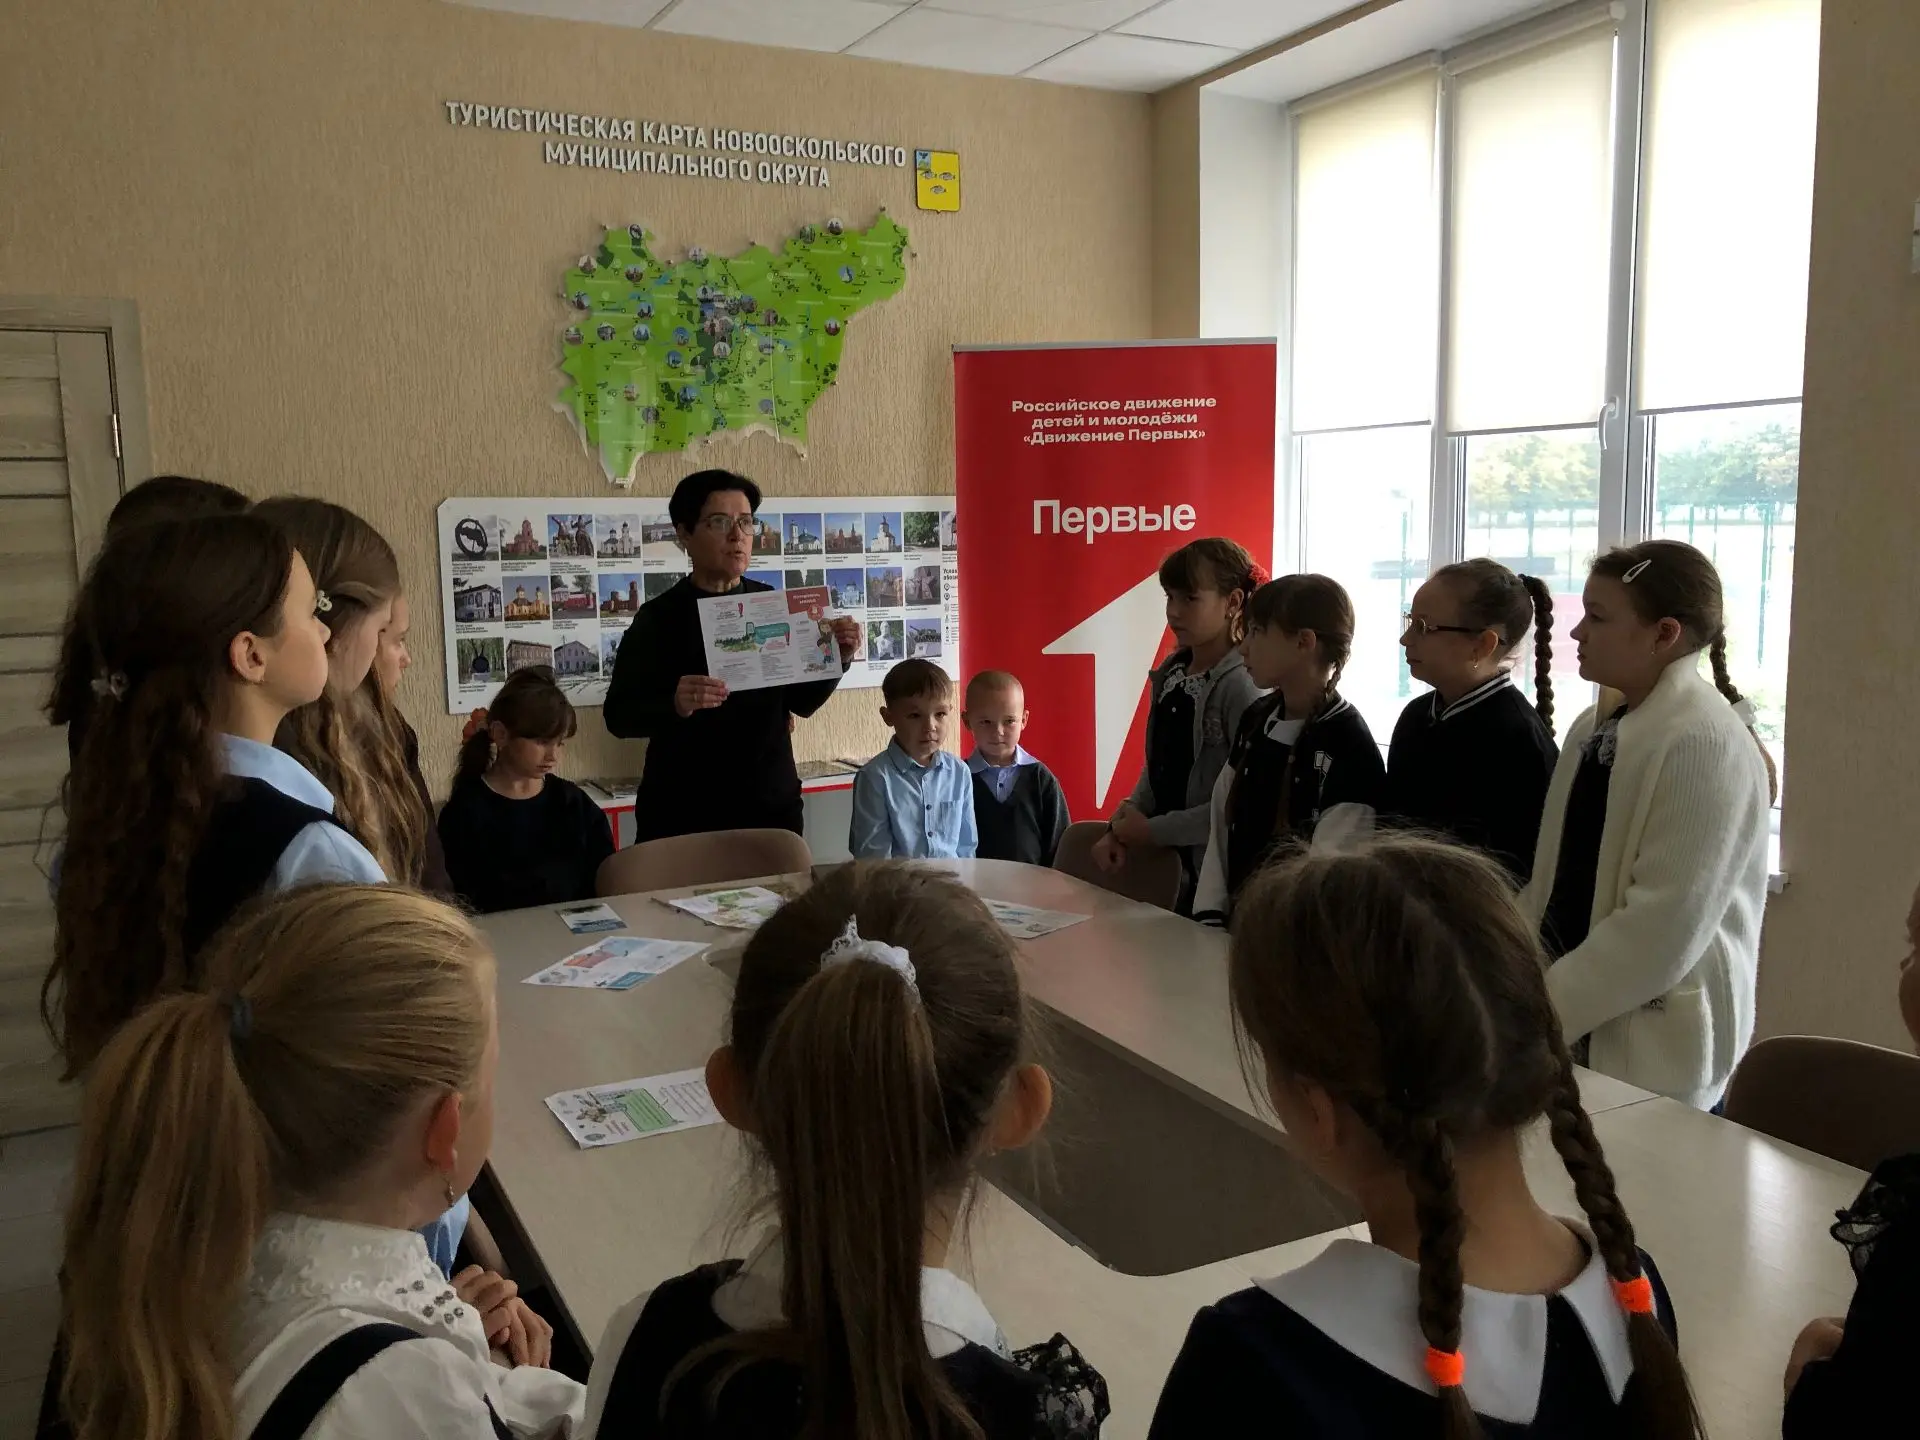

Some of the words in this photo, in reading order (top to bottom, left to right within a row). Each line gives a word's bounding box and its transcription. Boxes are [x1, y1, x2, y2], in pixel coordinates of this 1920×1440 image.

[446, 101, 636, 141] ТУРИСТИЧЕСКАЯ
[642, 121, 706, 149] КАРТА
[713, 128, 906, 168] НОВООСКОЛЬСКОГО
[545, 141, 752, 181] МУНИЦИПАЛЬНОГО
[758, 162, 830, 188] ОКРУГА
[1012, 398, 1121, 412] Российское
[1124, 396, 1217, 411] движение
[1032, 413, 1085, 429] детей
[1088, 415, 1100, 427] и
[1103, 411, 1198, 428] молодёжи
[1023, 430, 1125, 446] «Движение
[1128, 427, 1206, 443] Первых»
[1033, 499, 1197, 545] Первые
